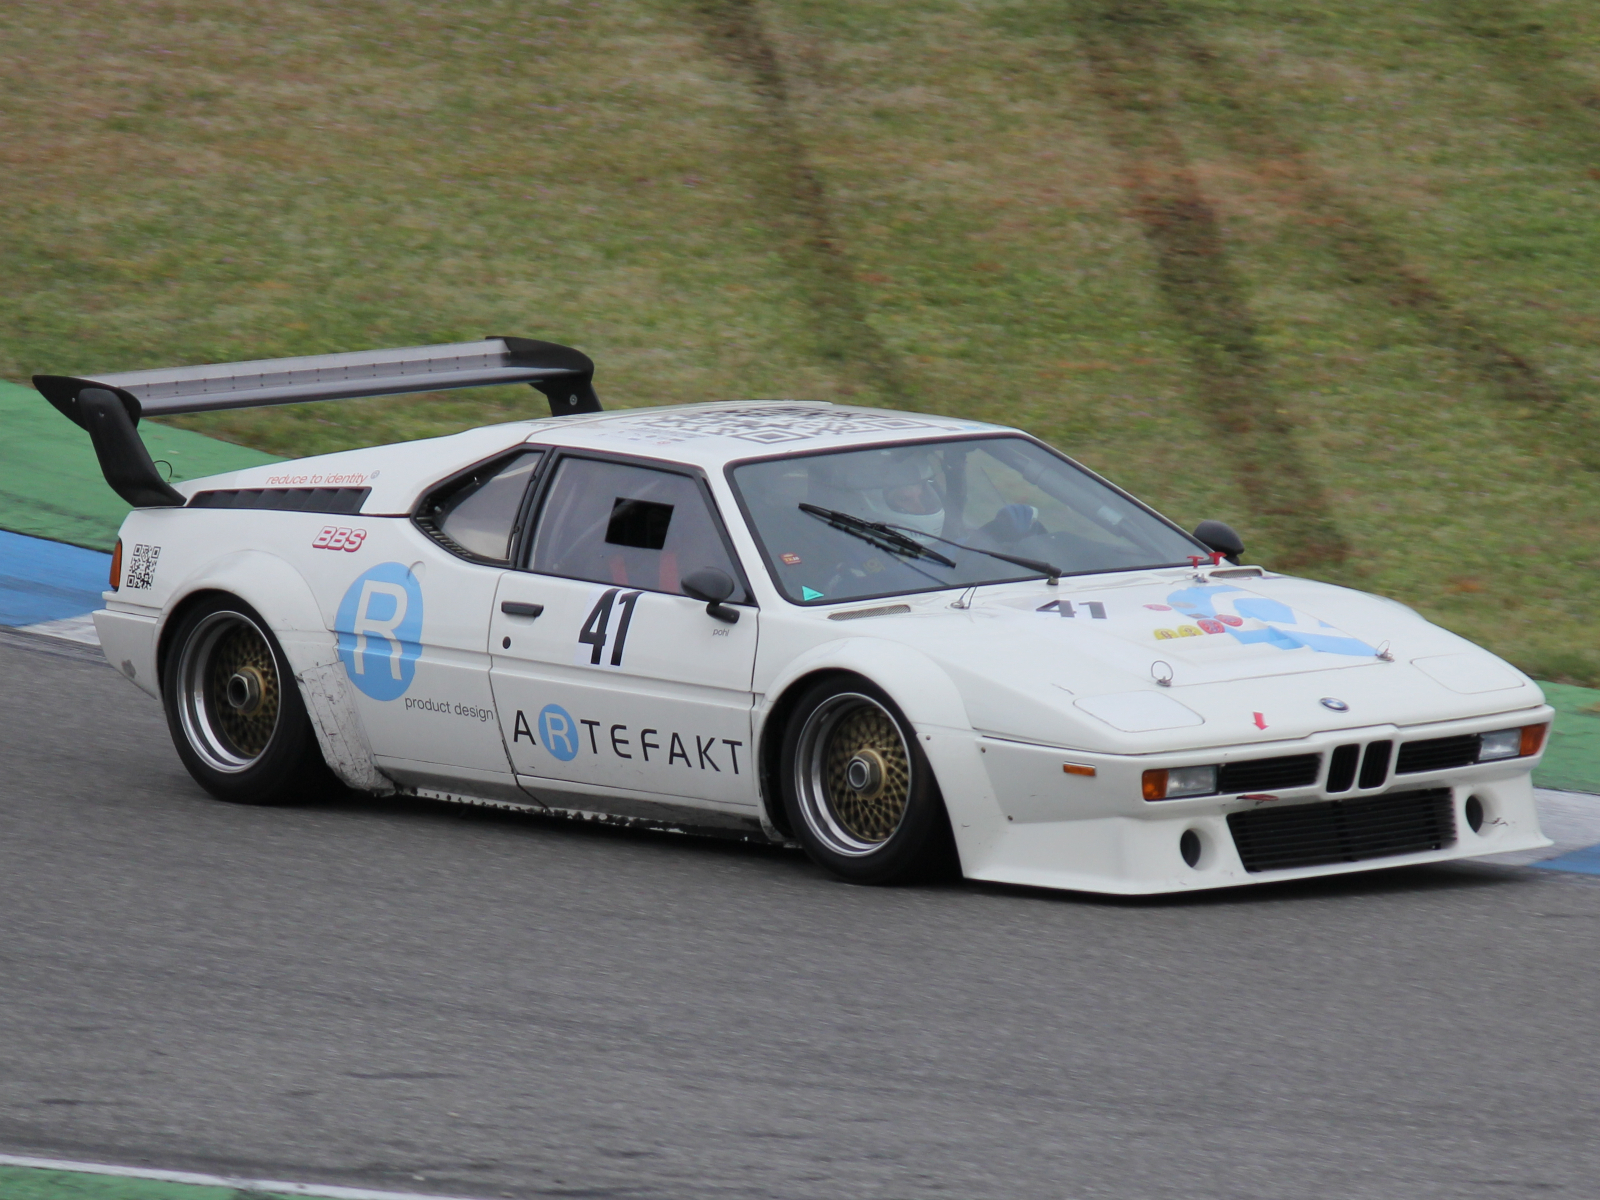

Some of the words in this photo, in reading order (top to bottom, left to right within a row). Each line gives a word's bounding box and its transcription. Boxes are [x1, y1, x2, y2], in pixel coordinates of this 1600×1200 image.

[265, 474, 308, 485] reduce
[310, 472, 323, 484] to
[324, 472, 369, 486] identity
[311, 525, 368, 553] BBS
[1035, 599, 1108, 620] 41
[351, 578, 409, 681] R
[577, 587, 645, 667] 41
[404, 697, 451, 714] product
[454, 702, 494, 722] design
[512, 705, 744, 775] ARTEFAKT
